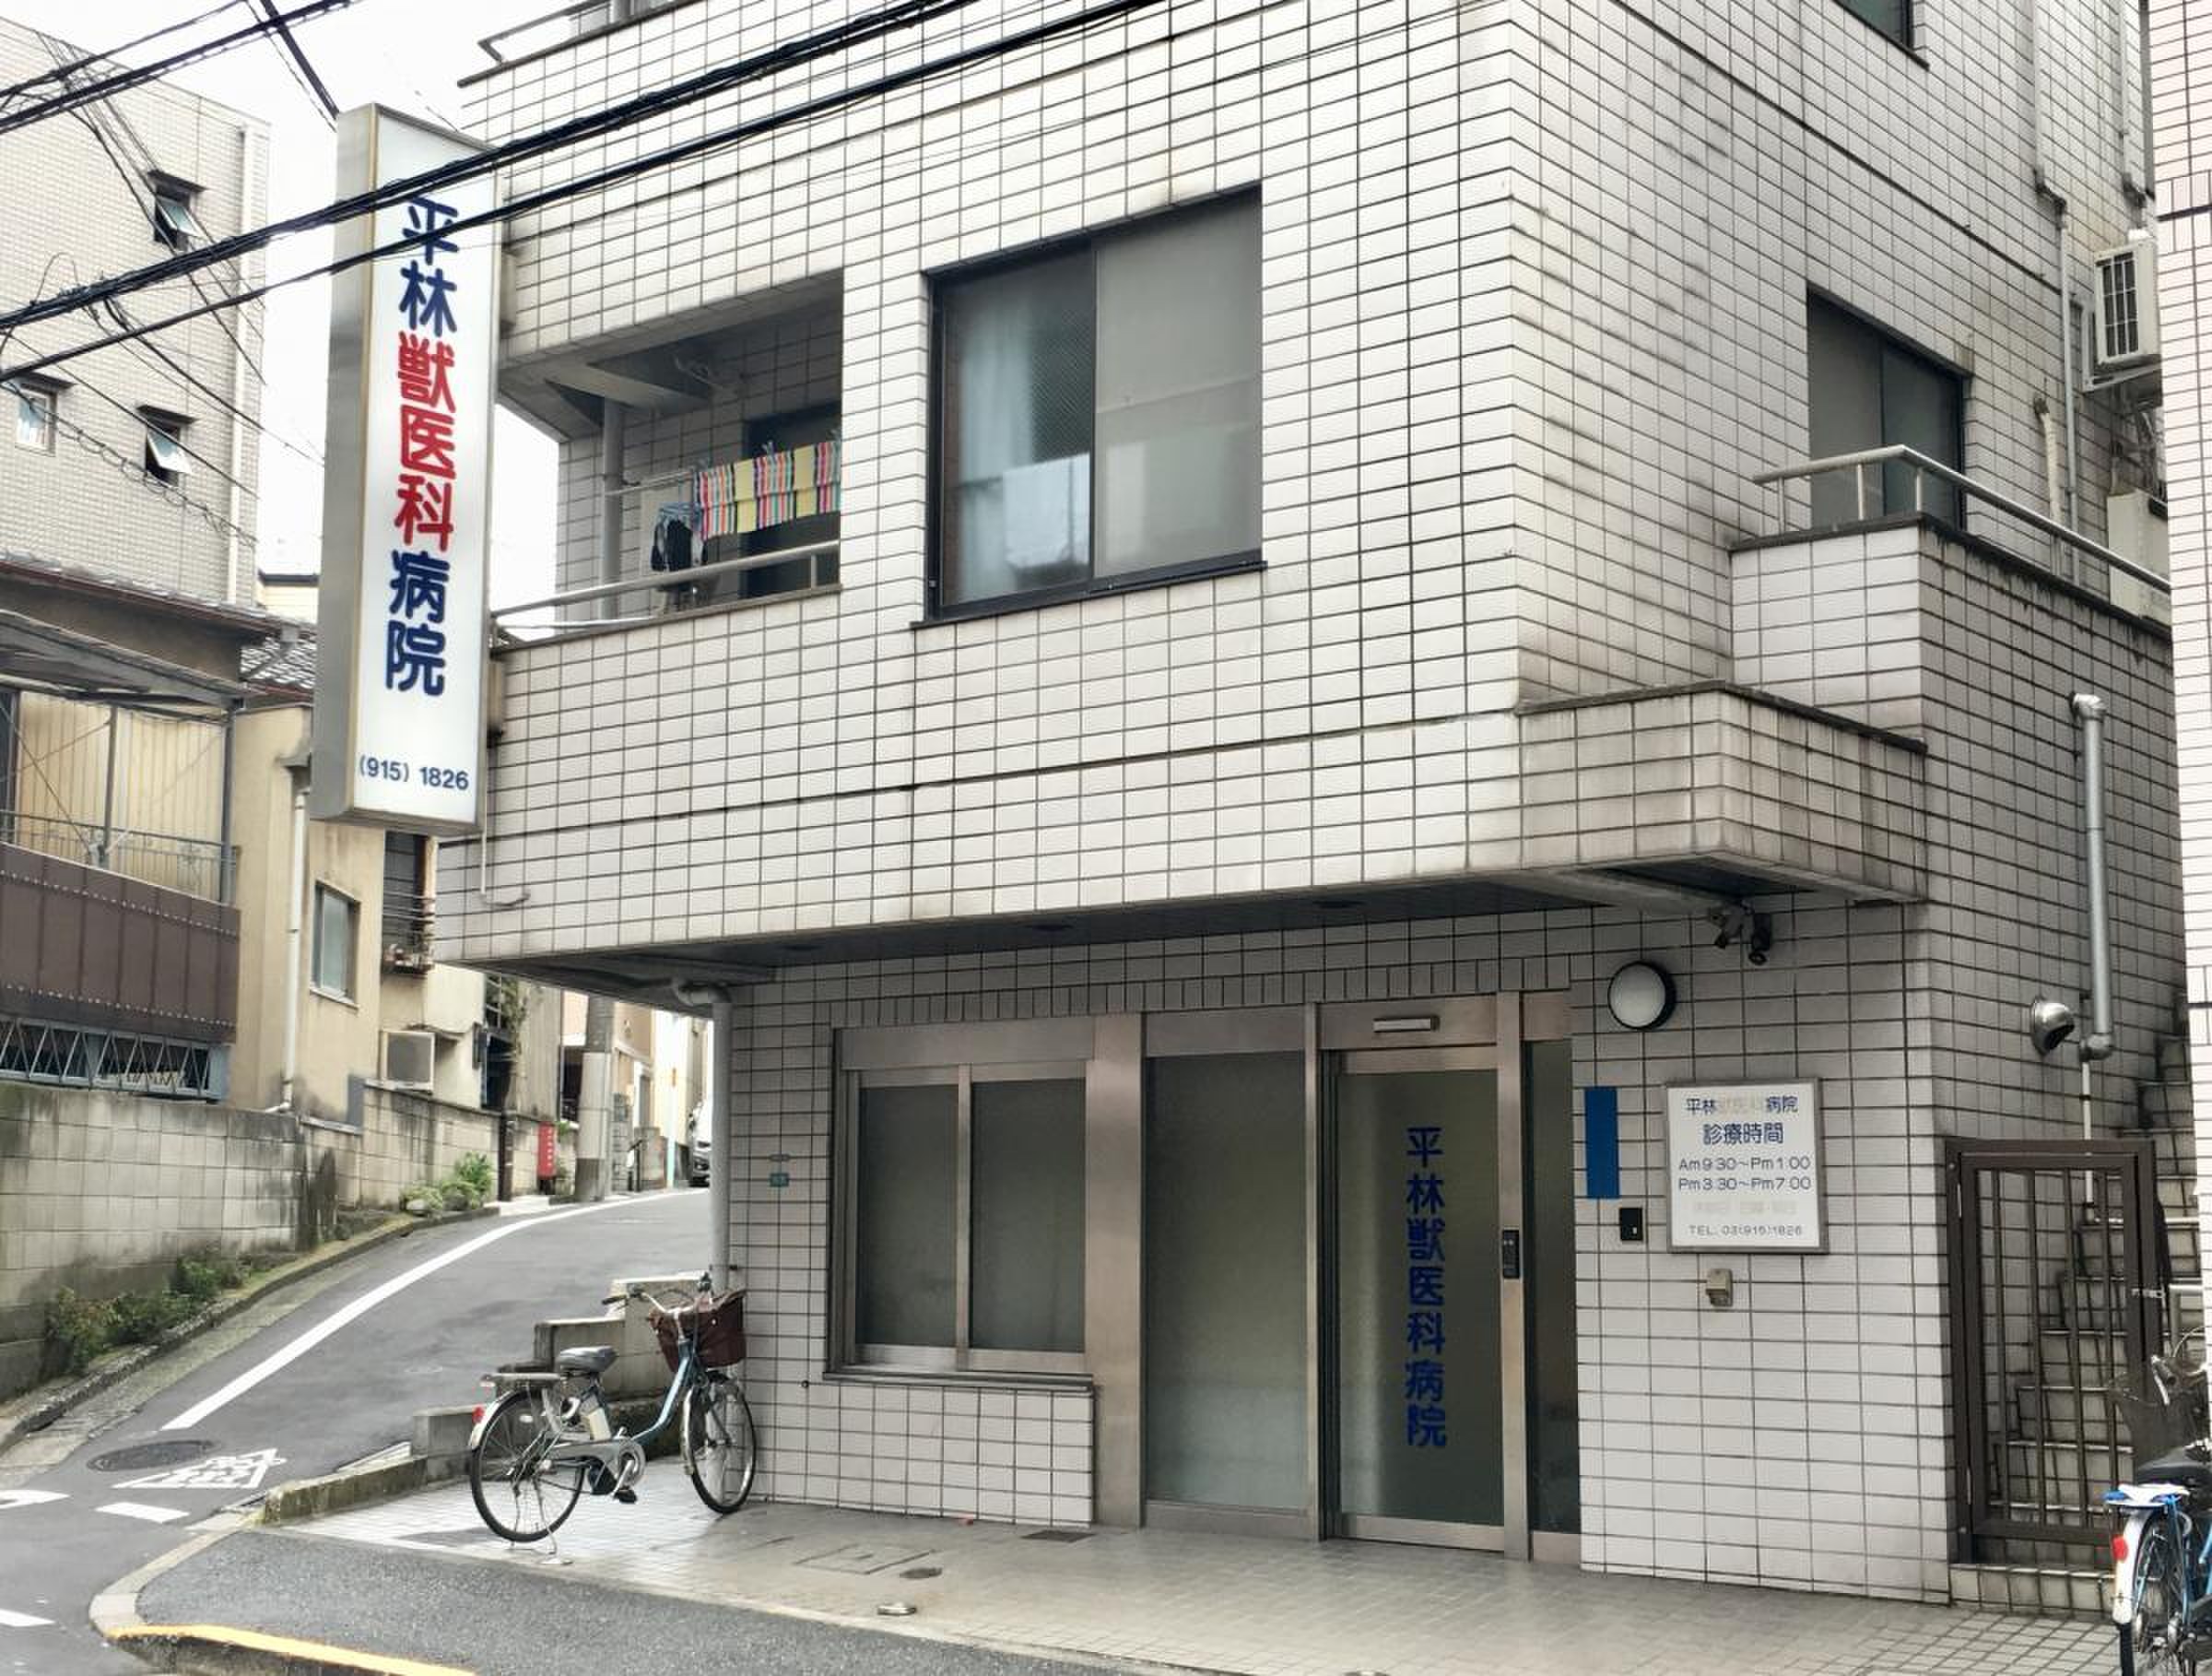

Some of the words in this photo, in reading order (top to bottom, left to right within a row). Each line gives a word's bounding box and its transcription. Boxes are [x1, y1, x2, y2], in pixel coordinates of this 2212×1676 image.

[386, 196, 459, 697] 平林獣医科病院
[359, 755, 409, 782] (915)
[419, 766, 469, 791] 1826
[1686, 1095, 1798, 1115] 平林病院
[1702, 1122, 1784, 1146] 診療時間
[1405, 1127, 1447, 1447] 平林獣医科病院
